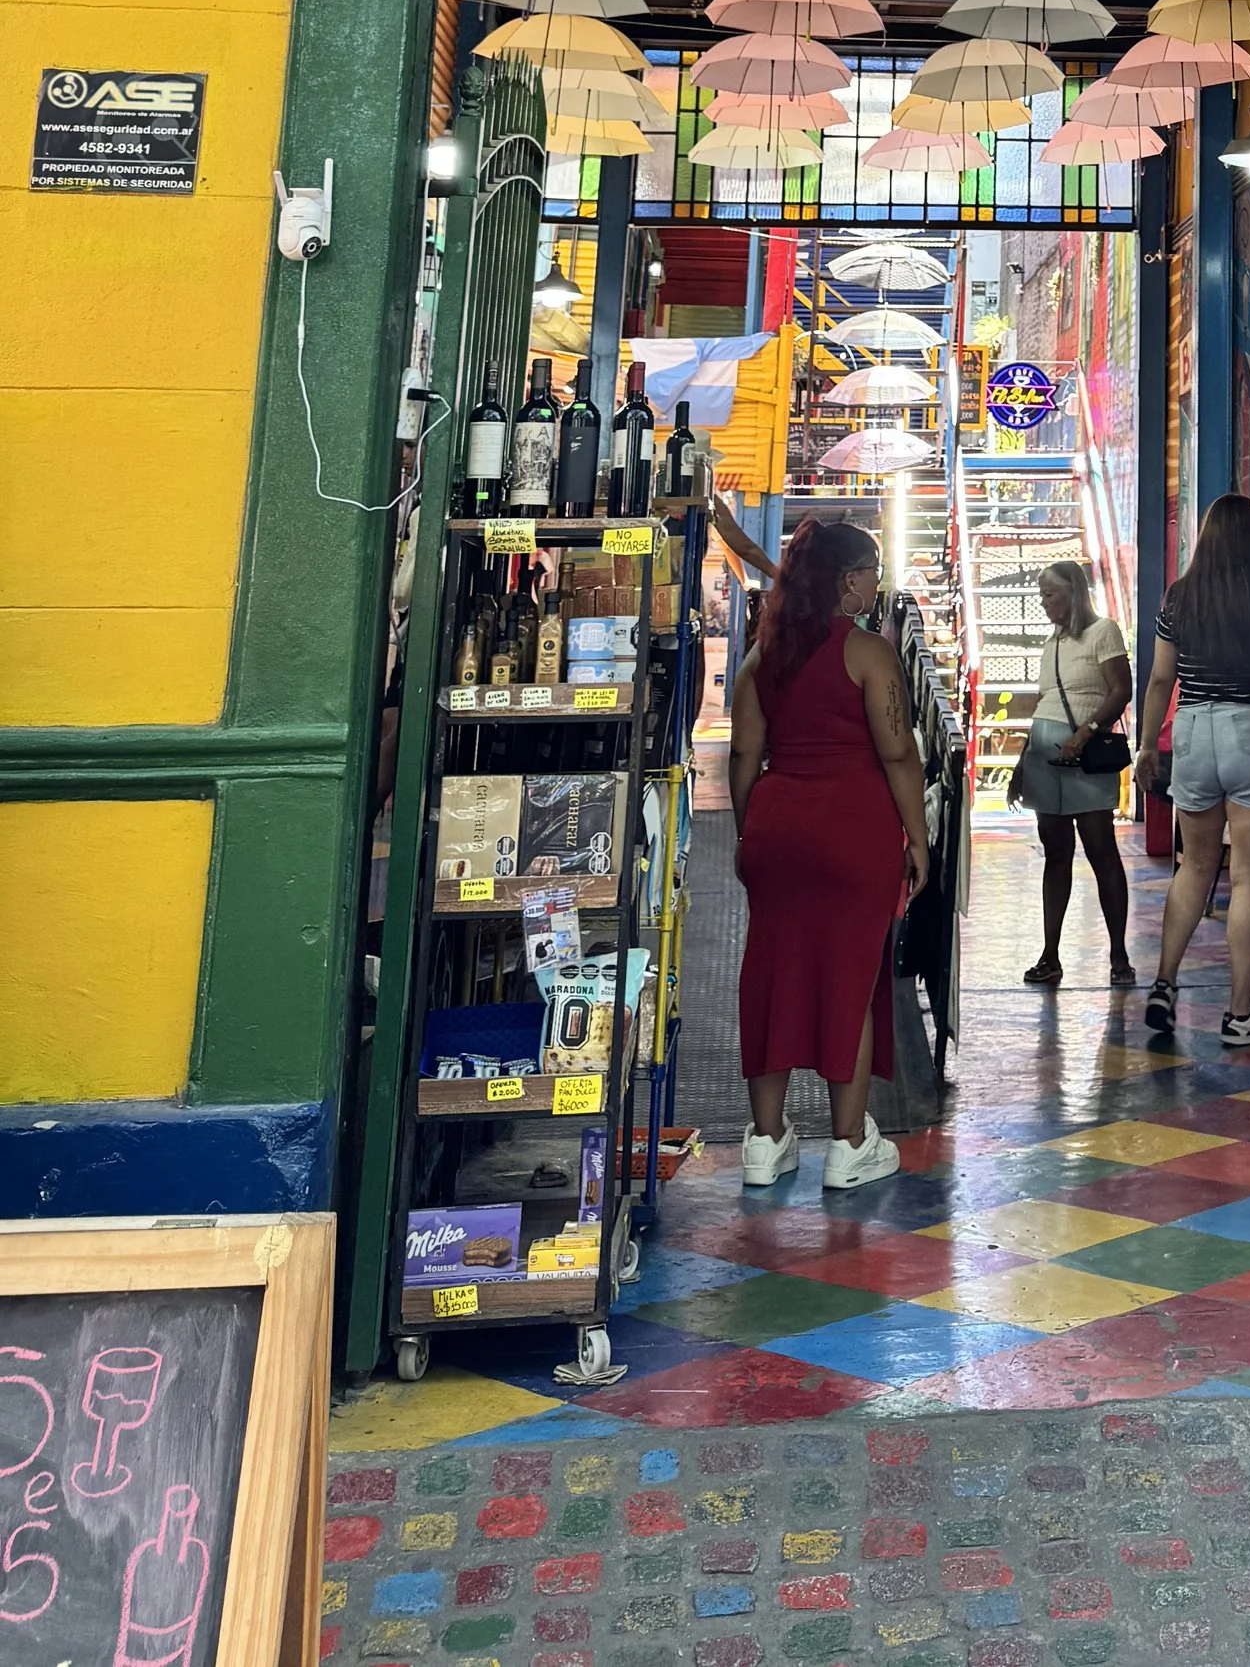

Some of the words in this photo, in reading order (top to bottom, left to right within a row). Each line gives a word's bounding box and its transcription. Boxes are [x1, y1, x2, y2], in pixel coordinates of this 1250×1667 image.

[84, 80, 197, 112] ASE
[41, 123, 194, 137] www.aseseguridad.com.ar
[78, 141, 151, 155] 4582-9341
[42, 163, 105, 174] PROPIEDAD
[106, 164, 185, 176] MONITOREADA
[31, 176, 54, 185] POR
[57, 177, 110, 187] SISTEMAS
[113, 178, 127, 187] DE
[129, 179, 193, 189] SEGURIDAD
[616, 530, 632, 540] NO
[603, 540, 650, 553] APOYARSE
[544, 985, 595, 996] MARADONA
[543, 994, 594, 1050] 10
[560, 1078, 593, 1089] OFERTA
[558, 1088, 573, 1096] PAN
[574, 1087, 598, 1096] DULCE
[558, 1098, 589, 1112] $6000
[405, 1224, 468, 1260] Milka
[423, 1264, 457, 1273] Mousse
